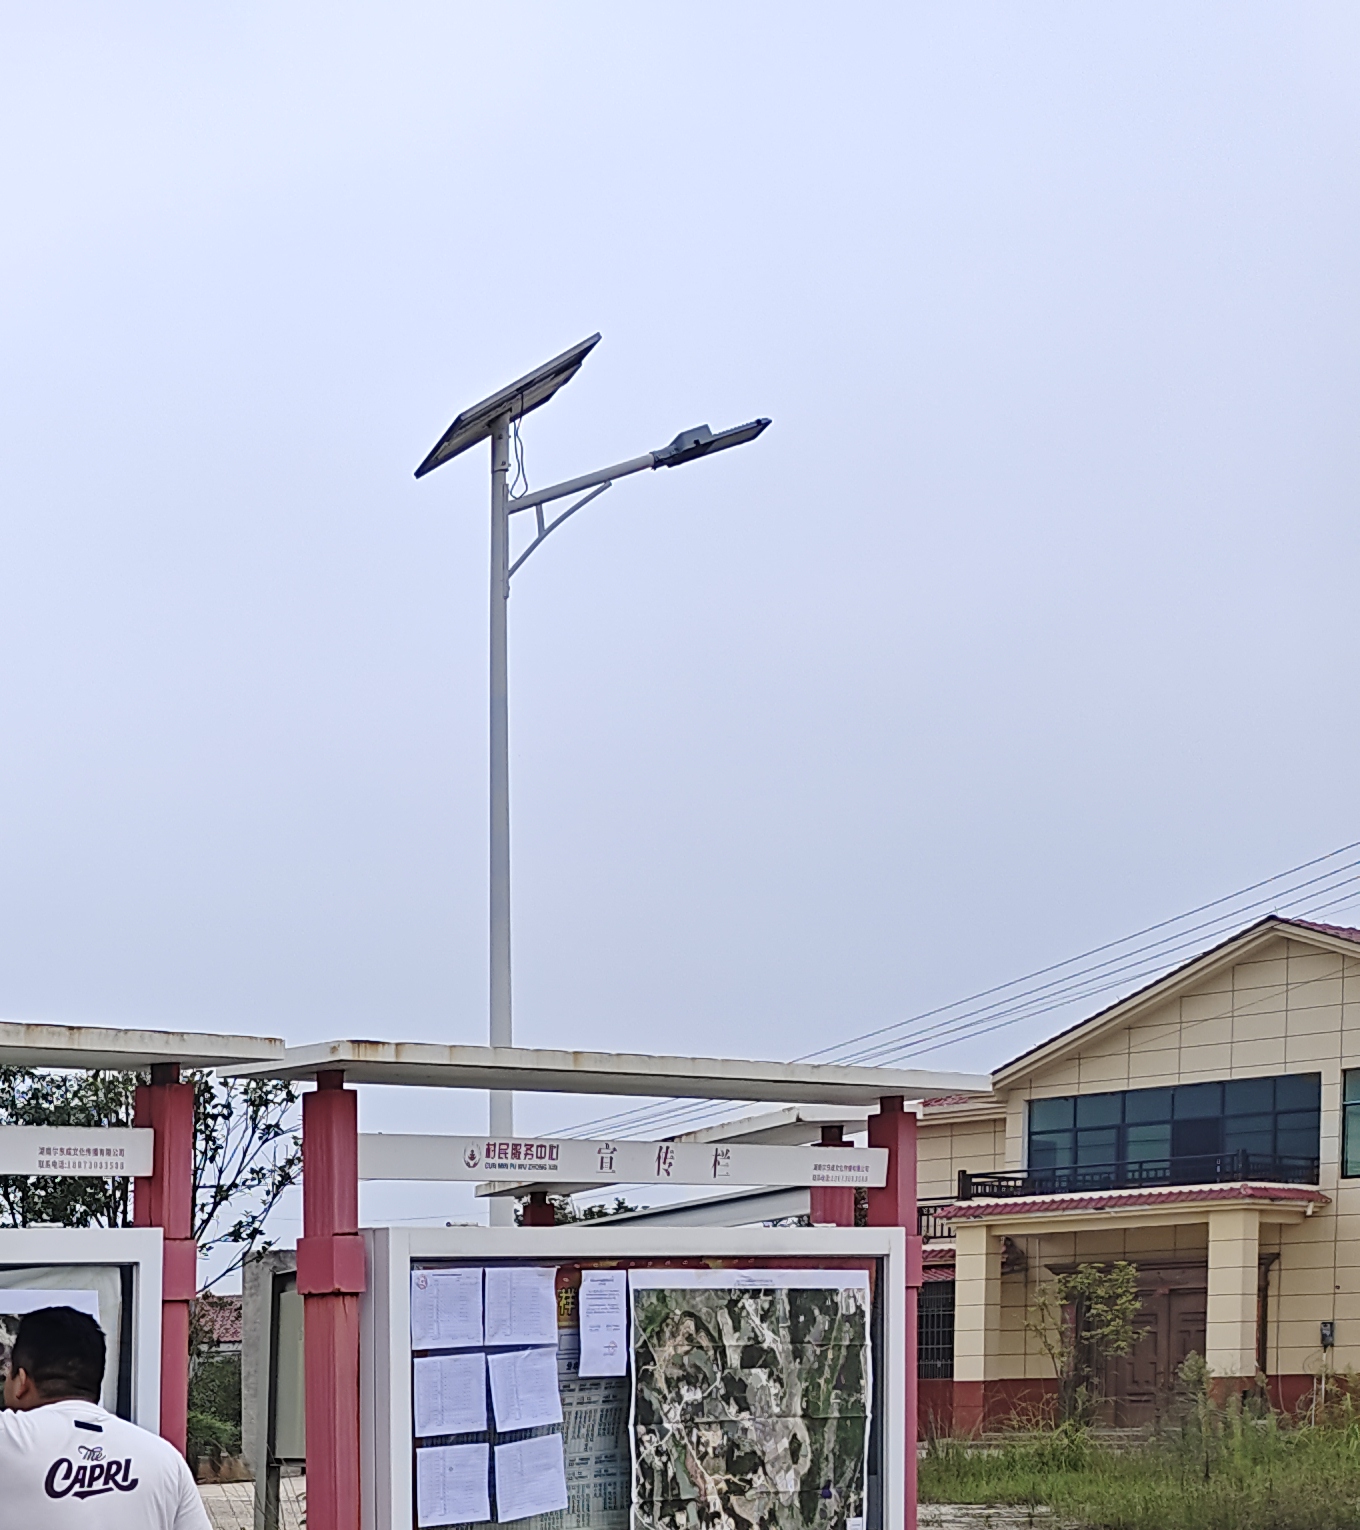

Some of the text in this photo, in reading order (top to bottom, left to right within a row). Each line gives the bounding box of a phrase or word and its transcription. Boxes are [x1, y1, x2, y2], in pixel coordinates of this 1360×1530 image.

[484, 1141, 559, 1161] 村民服务中心
[77, 1445, 106, 1462] The
[44, 1458, 139, 1499] CAPRI
